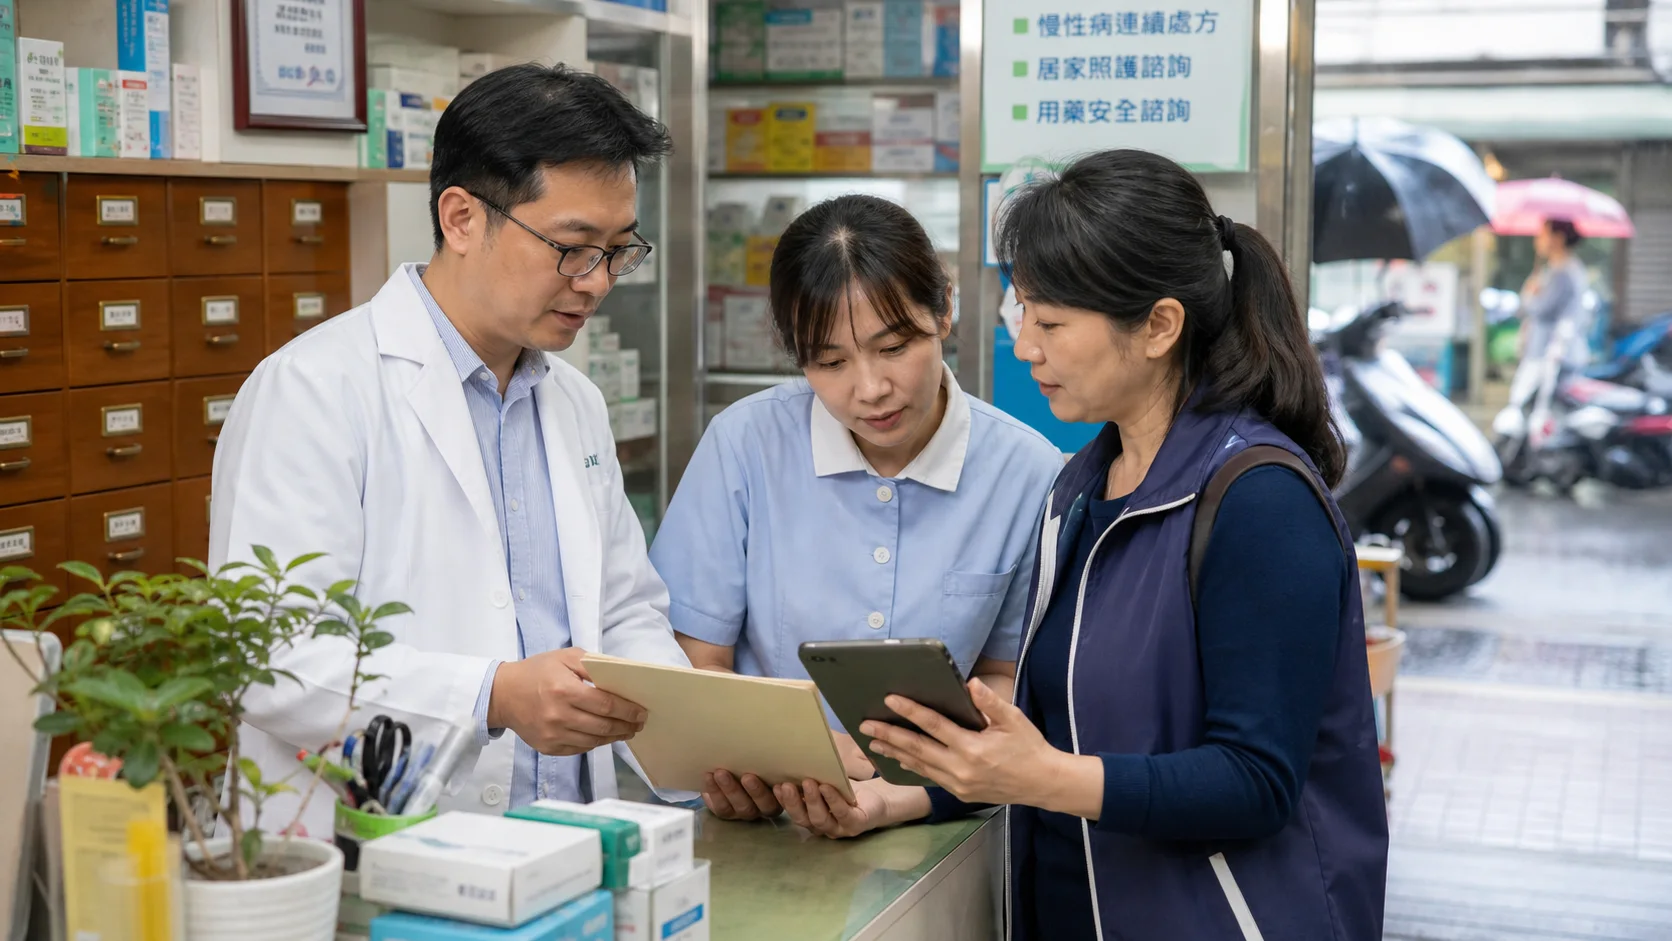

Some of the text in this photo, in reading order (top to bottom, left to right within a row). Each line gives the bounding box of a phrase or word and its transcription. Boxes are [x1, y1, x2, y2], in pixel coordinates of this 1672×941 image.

[1038, 10, 1218, 37] 慢性病連續處方
[1038, 54, 1191, 80] 居家照護諮詢
[1038, 97, 1190, 124] 用藥安全諮詢
